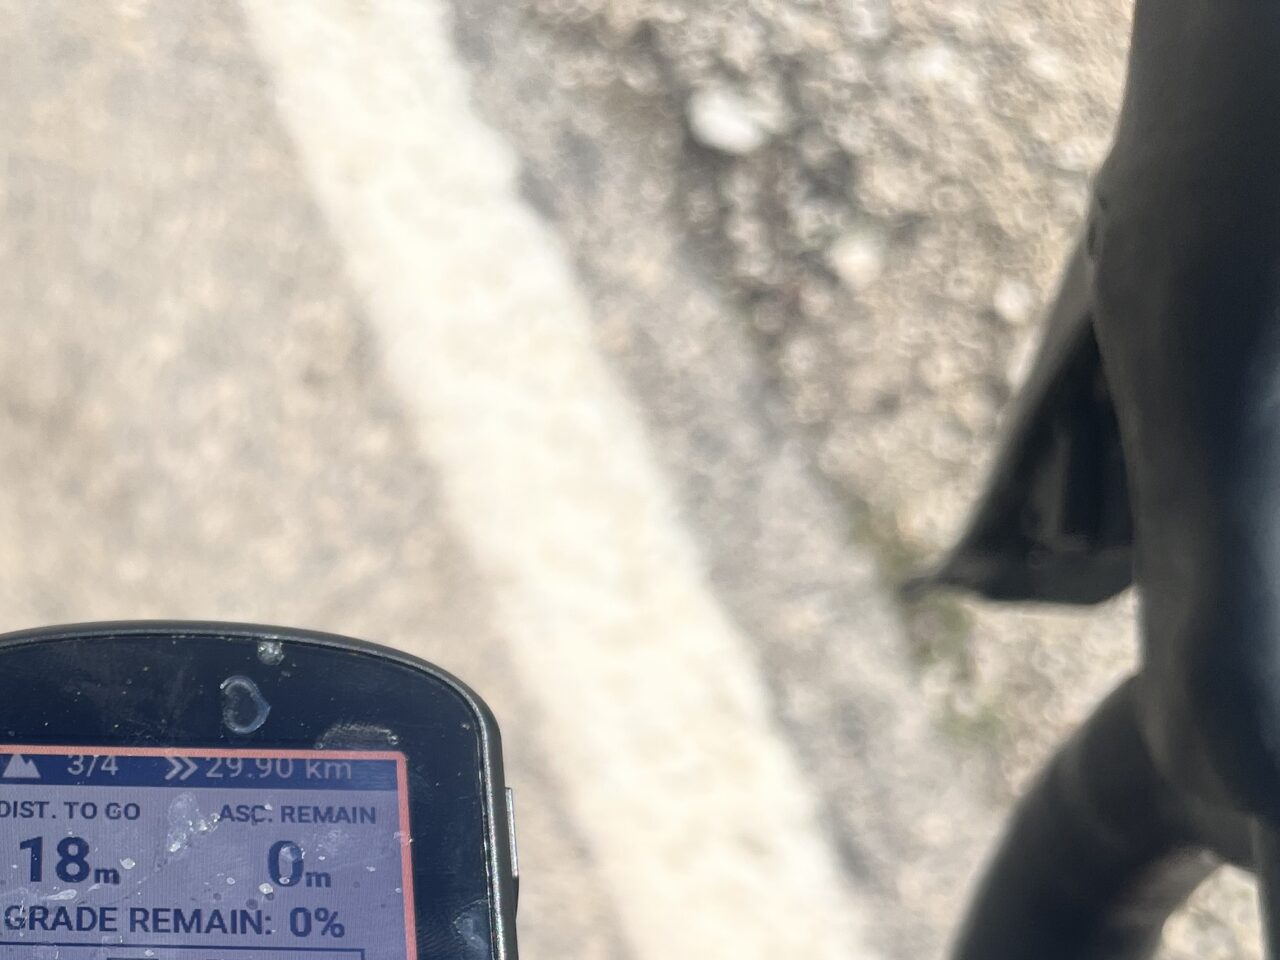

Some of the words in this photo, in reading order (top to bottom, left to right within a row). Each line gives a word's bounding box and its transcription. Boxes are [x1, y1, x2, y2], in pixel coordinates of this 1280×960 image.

[67, 755, 119, 777] 3/4
[205, 757, 294, 779] 29.90
[305, 758, 353, 779] km
[63, 801, 98, 820] TO
[105, 802, 141, 821] GO
[219, 804, 273, 824] ASC.
[280, 805, 377, 825] REMAIN
[4, 904, 118, 932] GRADE
[129, 906, 272, 935] REMAIN:
[289, 907, 346, 938] 0%
